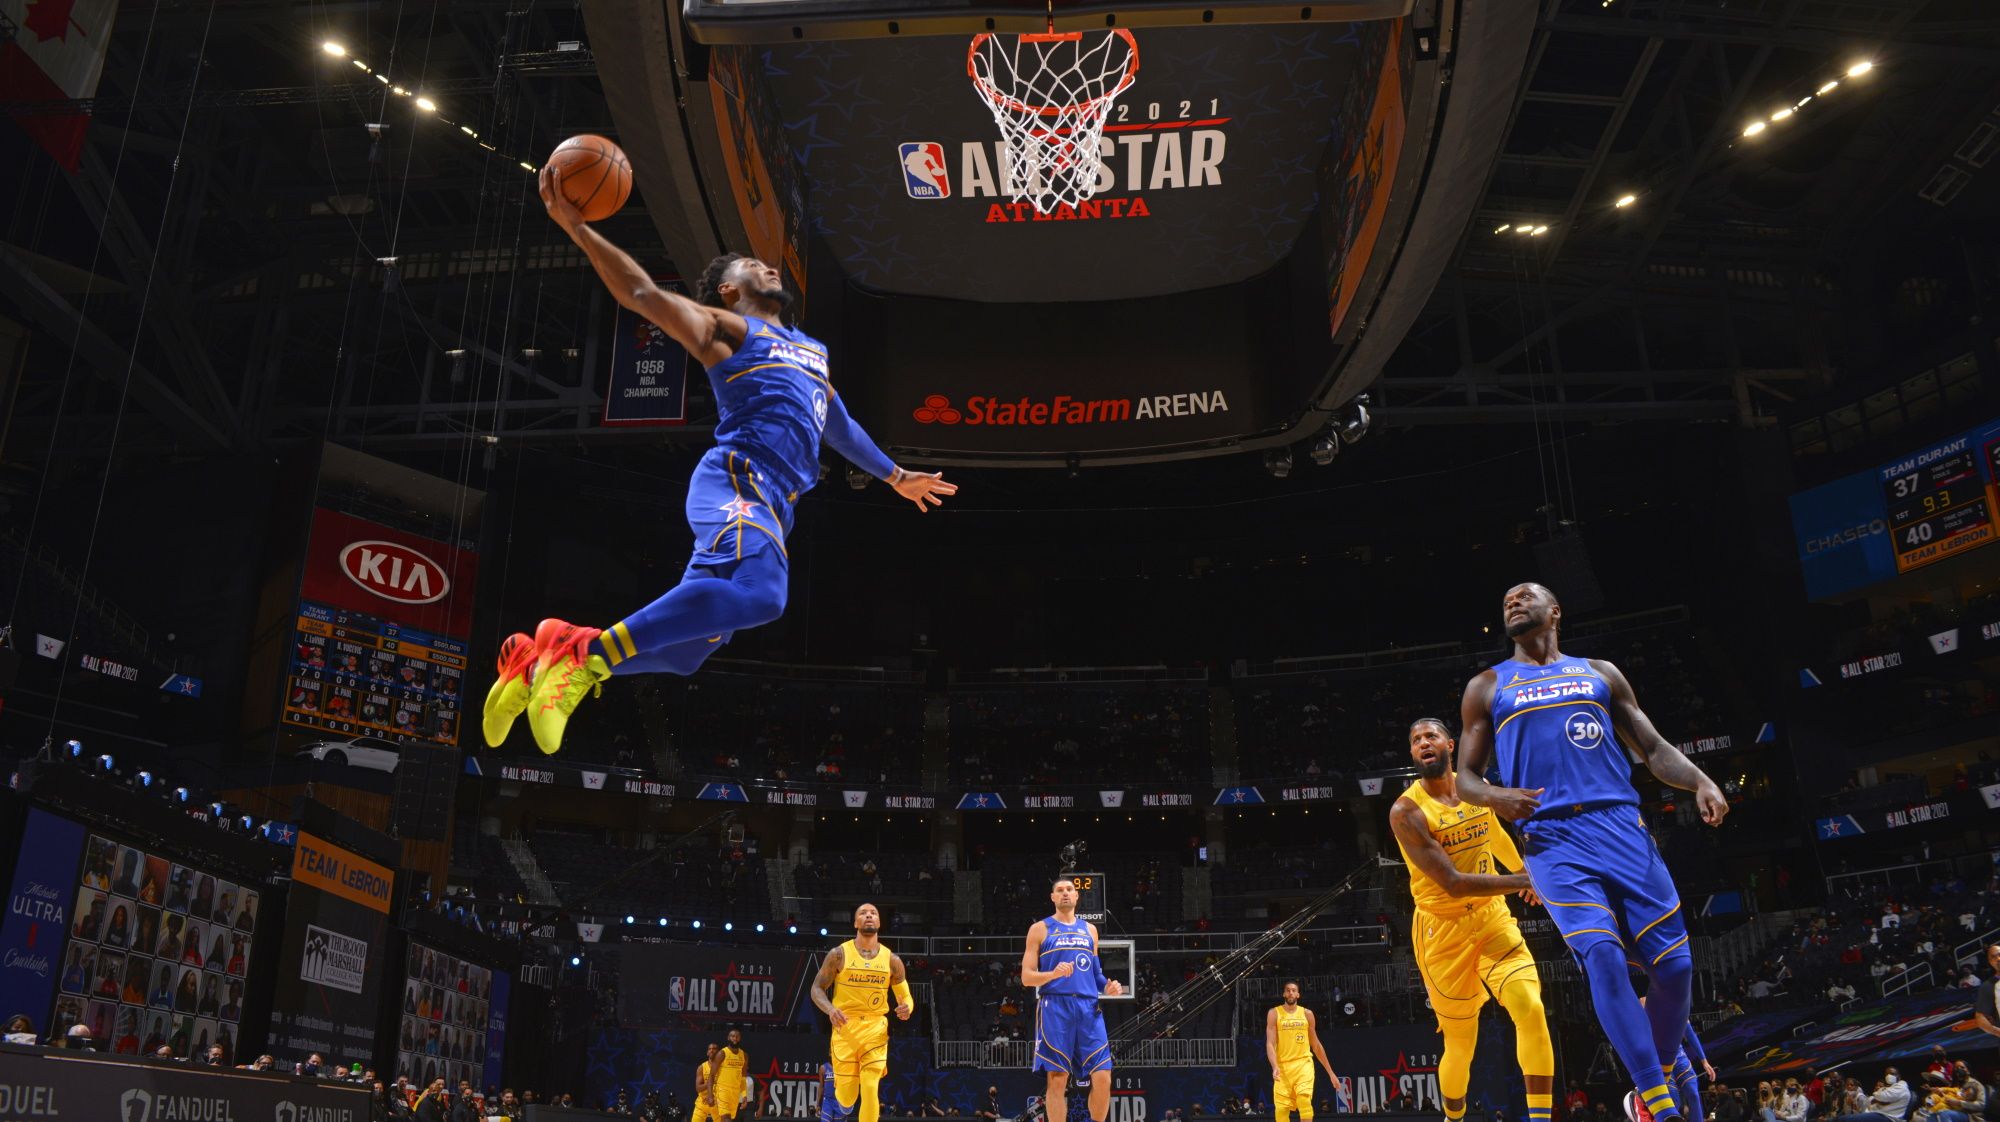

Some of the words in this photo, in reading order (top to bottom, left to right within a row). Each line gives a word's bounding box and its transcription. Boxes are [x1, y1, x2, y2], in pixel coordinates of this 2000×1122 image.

[1118, 98, 1218, 122] 2021
[1075, 129, 1227, 194] STAR
[913, 186, 935, 196] NBA
[985, 197, 1151, 224] ATLANTA
[635, 360, 665, 374] 1958
[639, 376, 656, 386] NBA
[623, 387, 670, 398] CHAMPIONS
[1136, 390, 1228, 420] ARENA
[1882, 459, 1915, 479] TEAM
[1918, 438, 1967, 466] DURANT
[1893, 473, 1919, 498] 37
[1923, 490, 1951, 514] 9.3
[1806, 523, 1870, 553] CHASE
[1906, 522, 1933, 545] 40
[1904, 546, 1937, 565] TEAM
[359, 547, 431, 598] KIA
[336, 629, 345, 637] 40
[385, 641, 396, 649] 40
[301, 668, 307, 677] 7
[314, 671, 320, 679] 0
[336, 676, 342, 684] 0
[349, 679, 356, 688] 0
[370, 683, 376, 692] 6
[383, 686, 390, 694] 0
[403, 691, 410, 700] 2
[294, 713, 300, 722] 0
[330, 720, 336, 729] 0
[343, 723, 349, 732] 0
[364, 728, 371, 737] 5
[1573, 722, 1599, 740] 30
[300, 845, 338, 881] TEAM
[1074, 877, 1092, 890] 9.2
[12, 895, 63, 924] ULTRA
[740, 964, 772, 975] 2021
[1080, 958, 1087, 967] 9
[686, 978, 718, 1012] ALL
[726, 979, 774, 1015] STAR
[1410, 1054, 1438, 1066] 202
[1116, 1078, 1141, 1089] 021
[1399, 1073, 1441, 1112] STA
[154, 1094, 234, 1122] FANDUEL
[300, 1105, 353, 1122] FANDUEL
[1109, 1096, 1147, 1122] TAR
